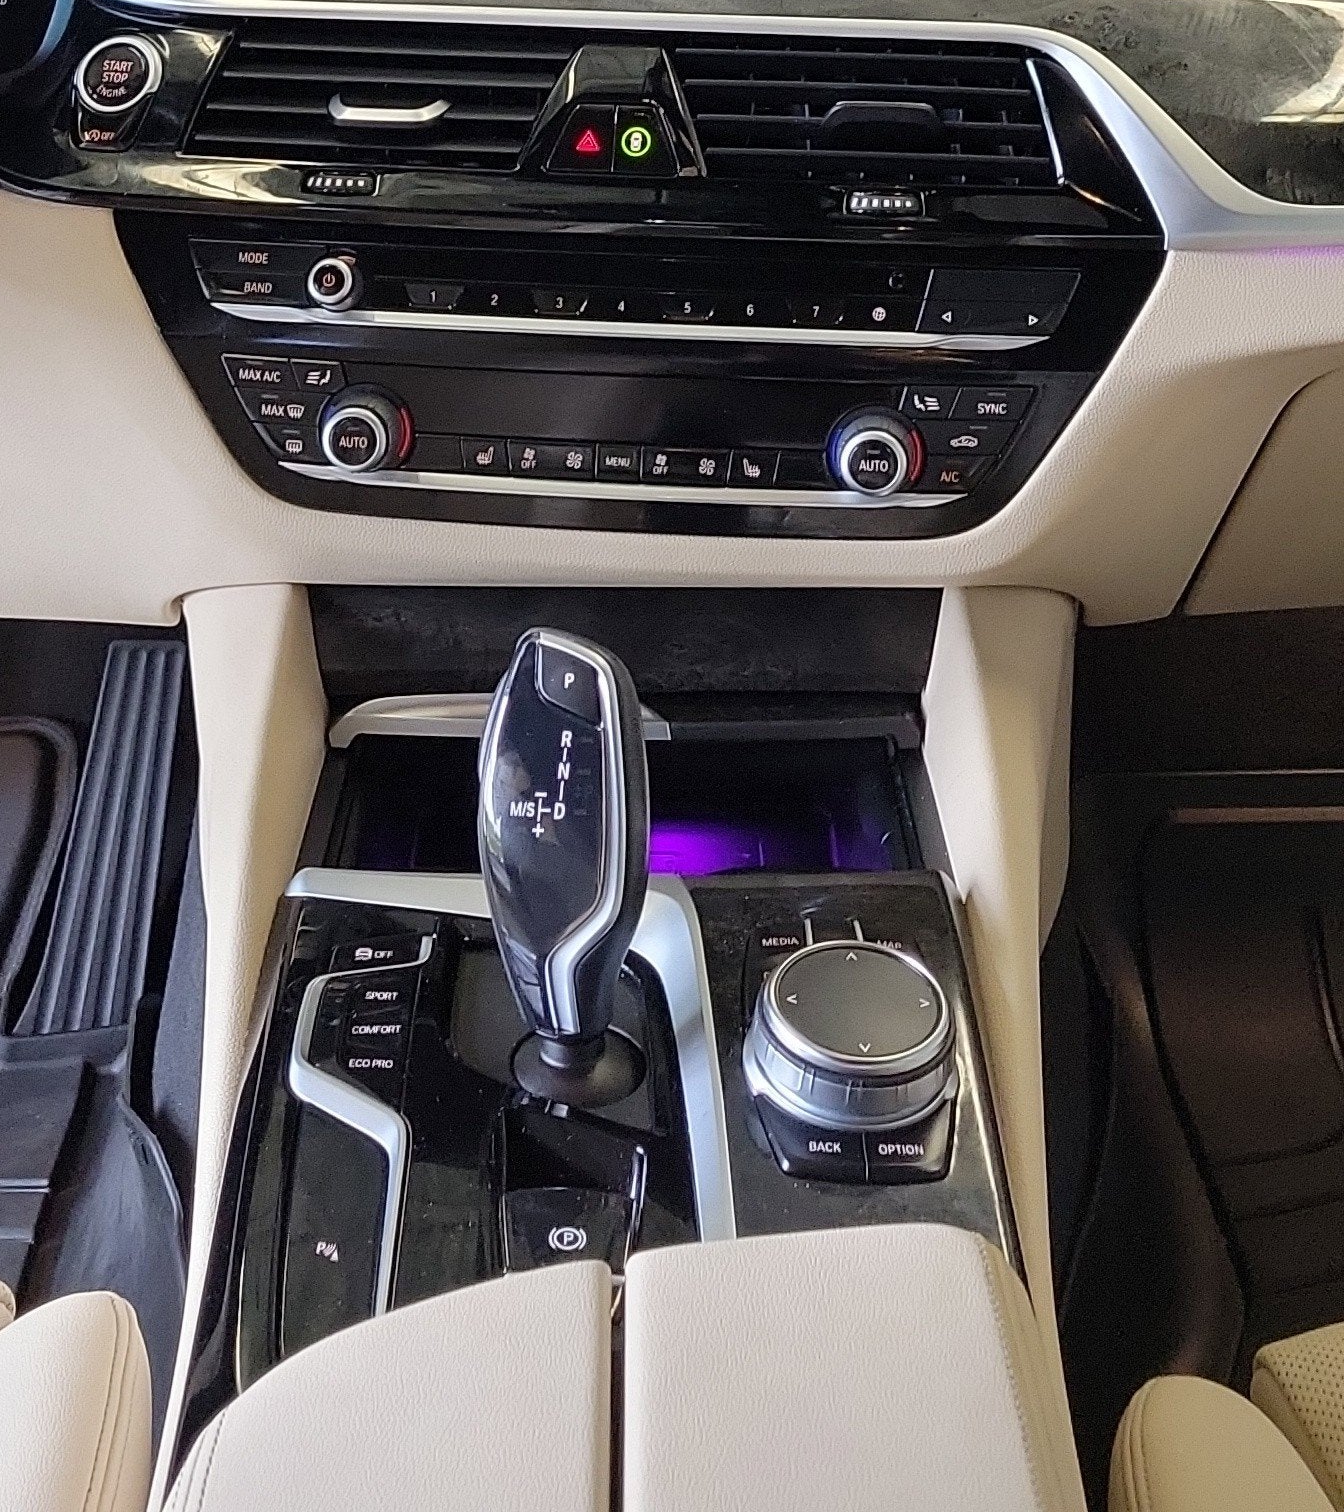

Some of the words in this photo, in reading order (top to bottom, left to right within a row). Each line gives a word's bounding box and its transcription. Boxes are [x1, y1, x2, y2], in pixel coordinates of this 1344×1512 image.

[102, 59, 134, 72] START
[101, 72, 129, 83] STOP
[96, 84, 128, 98] ENGINE
[238, 252, 269, 264] MODE
[243, 282, 273, 294] BAND
[238, 368, 262, 381] MAX
[263, 369, 282, 383] A/C
[261, 405, 285, 417] MAX
[977, 403, 1007, 415] SYNC
[338, 436, 368, 449] AUTO
[606, 456, 631, 468] MENU
[859, 460, 889, 473] AUTO
[940, 470, 960, 483] A/C
[564, 672, 575, 689] P
[561, 730, 573, 748] R
[557, 763, 571, 780] N
[509, 801, 535, 818] M/S
[553, 802, 565, 820] D
[762, 936, 800, 947] MEDIA
[374, 950, 394, 960] OFF
[365, 990, 399, 1001] SPORT
[351, 1024, 402, 1035] COMFORT
[348, 1058, 370, 1069] ECO
[371, 1059, 394, 1070] PRO
[808, 1140, 842, 1154] BACK
[878, 1143, 925, 1157] OPTION
